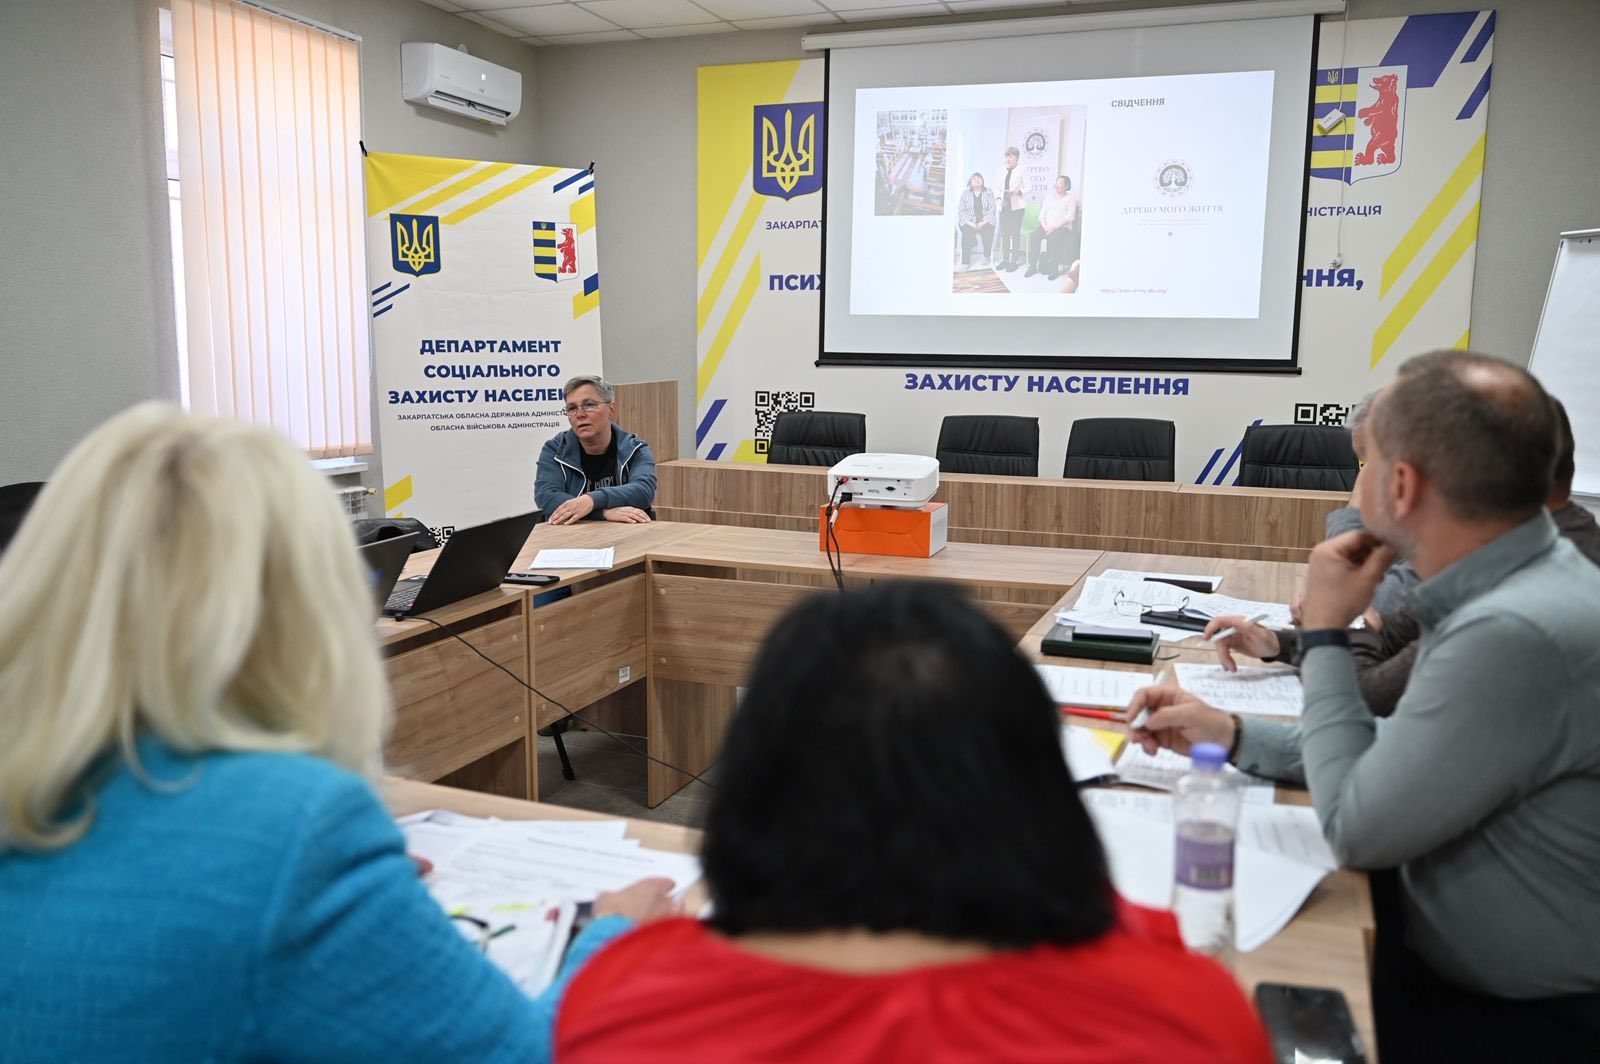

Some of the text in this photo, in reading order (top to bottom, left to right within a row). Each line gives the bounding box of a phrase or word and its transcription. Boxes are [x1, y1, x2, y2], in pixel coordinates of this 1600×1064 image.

[1111, 98, 1165, 108] СВІДЧЕННЯ
[1121, 205, 1223, 215] ДЕРЕВО МОГО ЖИТТЯ
[420, 340, 562, 355] ДЕПАРТАМЕНТ
[423, 364, 561, 380] СОЦІАЛЬНОГО
[904, 373, 1190, 396] ЗАХИСТУ НАСЕЛЕННЯ
[388, 389, 479, 404] ЗАХИСТУ
[397, 412, 454, 421] ЗАКАРПАТСЬКА
[456, 412, 490, 420] ОБЛАСНА
[491, 410, 530, 419] ДЕРЖАВНА
[430, 421, 560, 432] ОБЛАСНА ВІЙСЬКОВА АДМІНІСТРАЦІЯ
